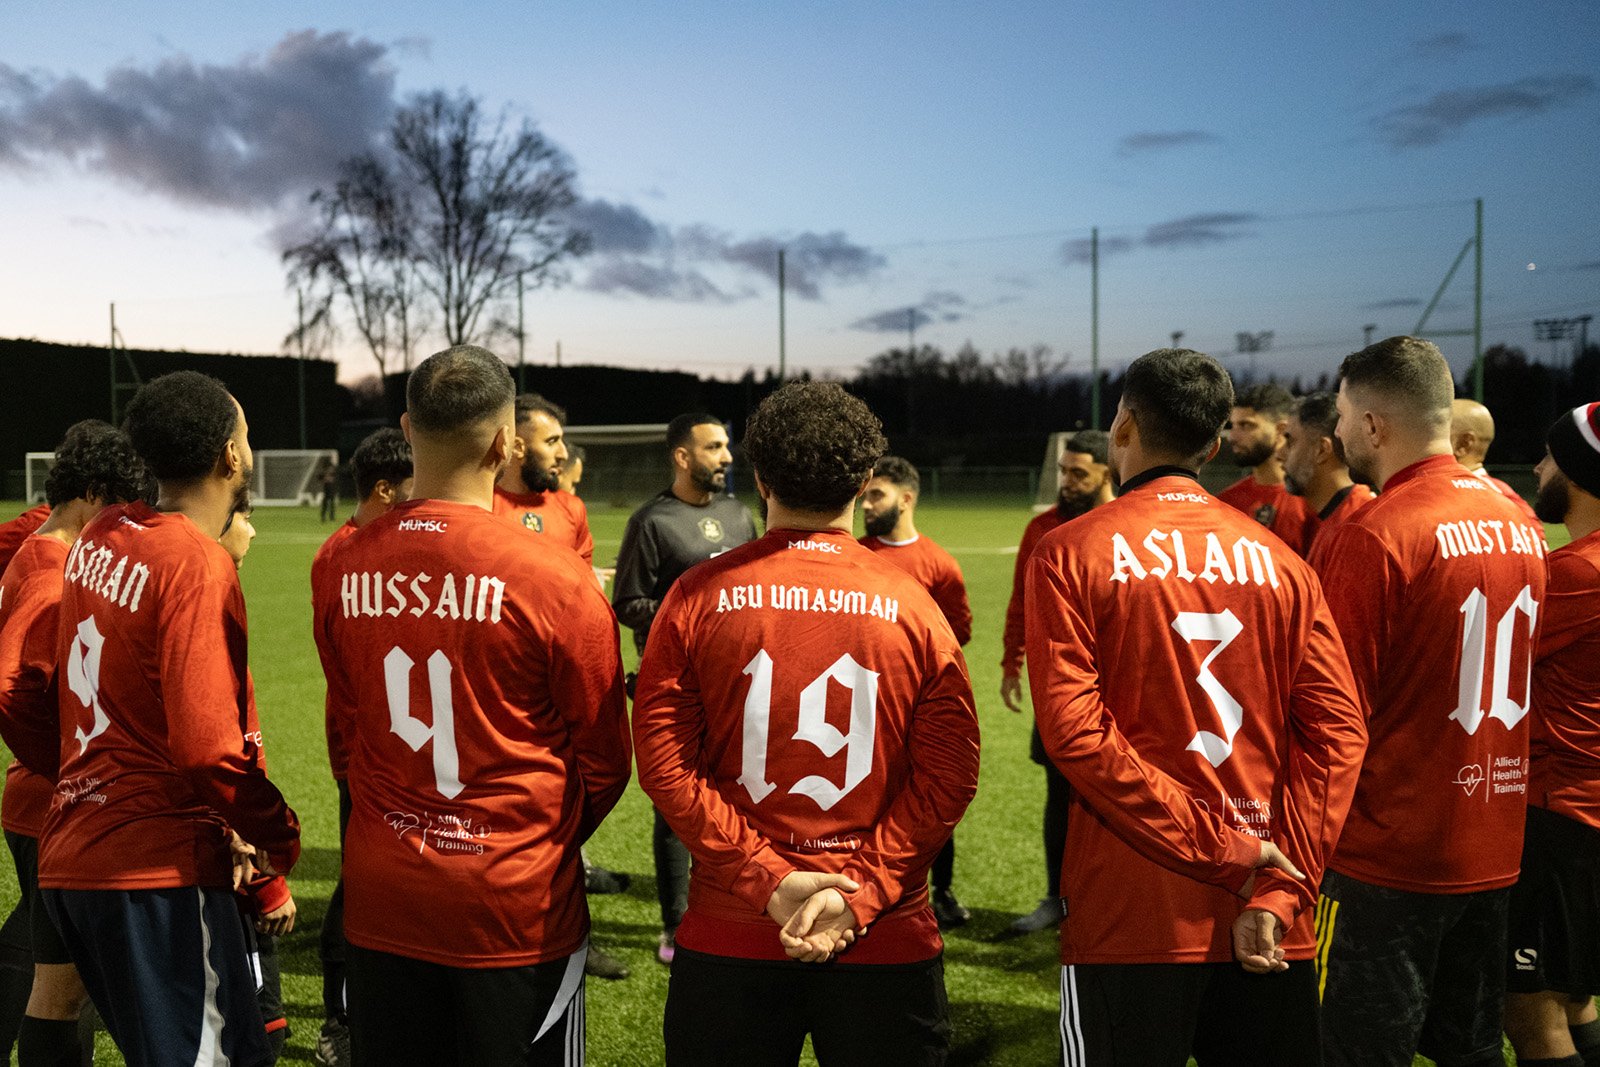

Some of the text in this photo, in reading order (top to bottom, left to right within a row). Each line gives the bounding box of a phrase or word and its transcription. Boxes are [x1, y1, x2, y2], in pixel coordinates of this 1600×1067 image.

[1109, 528, 1280, 590] ASLAM
[341, 571, 506, 625] HUSSAIN
[716, 583, 899, 624] ABU UMAYMAH
[67, 614, 112, 757] 9
[1448, 584, 1540, 735] 10
[1171, 607, 1244, 769] 3
[383, 645, 467, 800] 4
[735, 648, 881, 812] 19
[1492, 769, 1522, 781] Health
[1493, 756, 1520, 768] Allied
[1493, 782, 1526, 795] Training
[434, 837, 484, 856] Training
[803, 835, 840, 849] Allied
